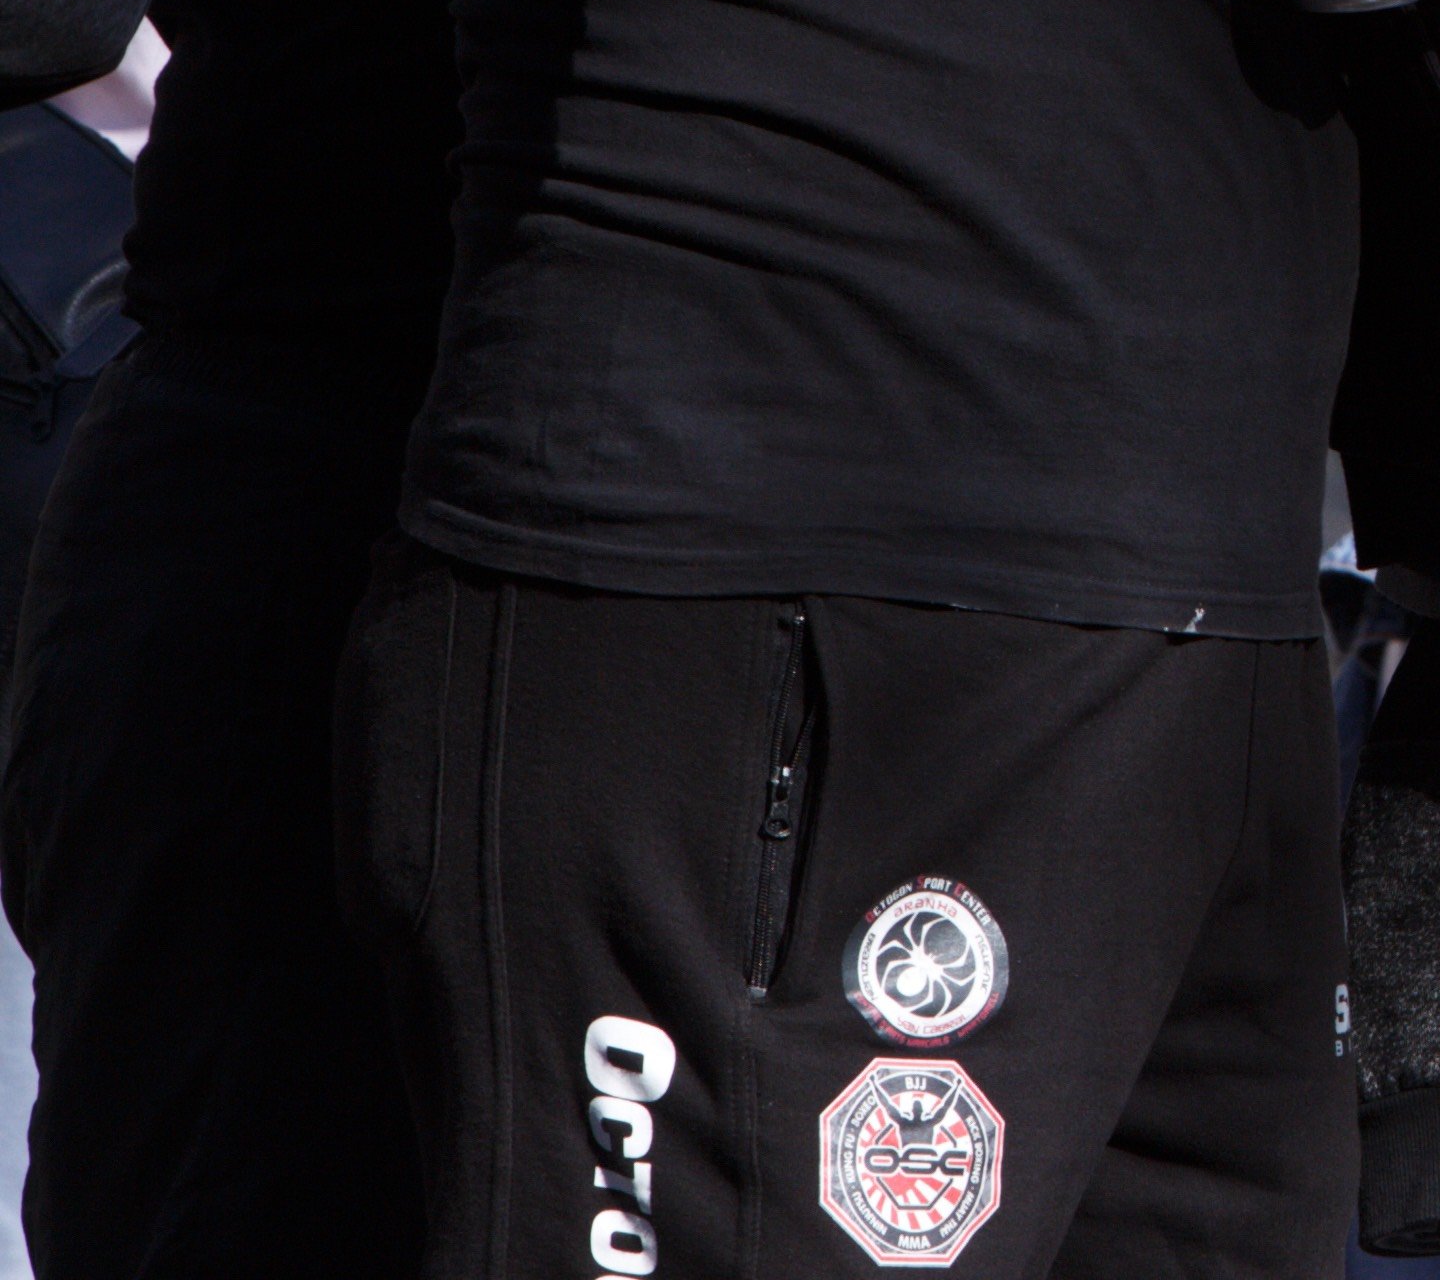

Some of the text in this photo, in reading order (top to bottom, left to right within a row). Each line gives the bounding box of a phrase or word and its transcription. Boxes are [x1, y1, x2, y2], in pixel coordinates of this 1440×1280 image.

[916, 875, 952, 893] SPORT
[953, 882, 992, 926] CENTER
[904, 1076, 928, 1091] BJJ
[584, 1015, 677, 1280] OCTO
[897, 1234, 931, 1250] MMA
